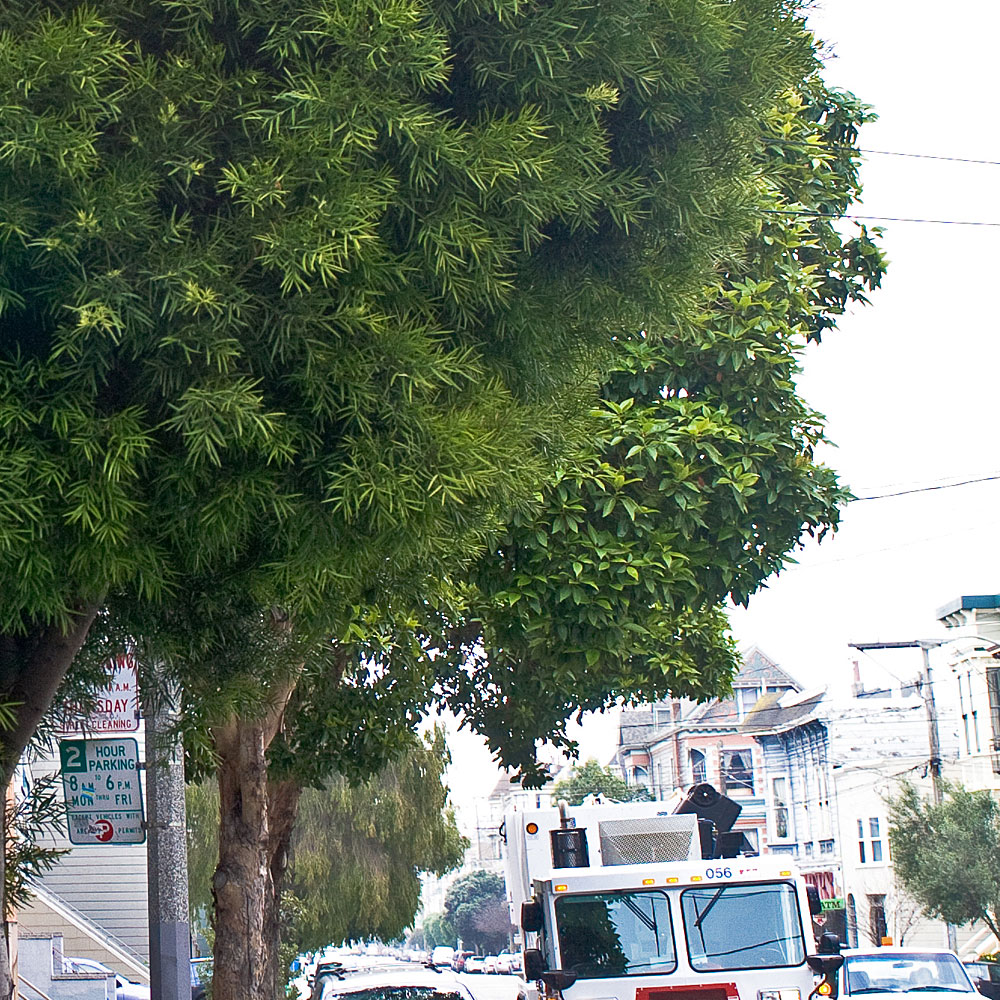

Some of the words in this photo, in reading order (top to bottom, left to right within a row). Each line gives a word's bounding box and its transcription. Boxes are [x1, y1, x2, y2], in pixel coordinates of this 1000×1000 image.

[92, 719, 131, 729] CLEANING
[66, 746, 81, 767] 2
[96, 745, 126, 757] HOUR
[88, 759, 135, 771] PARKING
[69, 775, 78, 791] 8
[106, 774, 115, 790] 6
[72, 795, 94, 806] MON
[115, 794, 132, 805] FRI
[705, 867, 732, 879] 056
